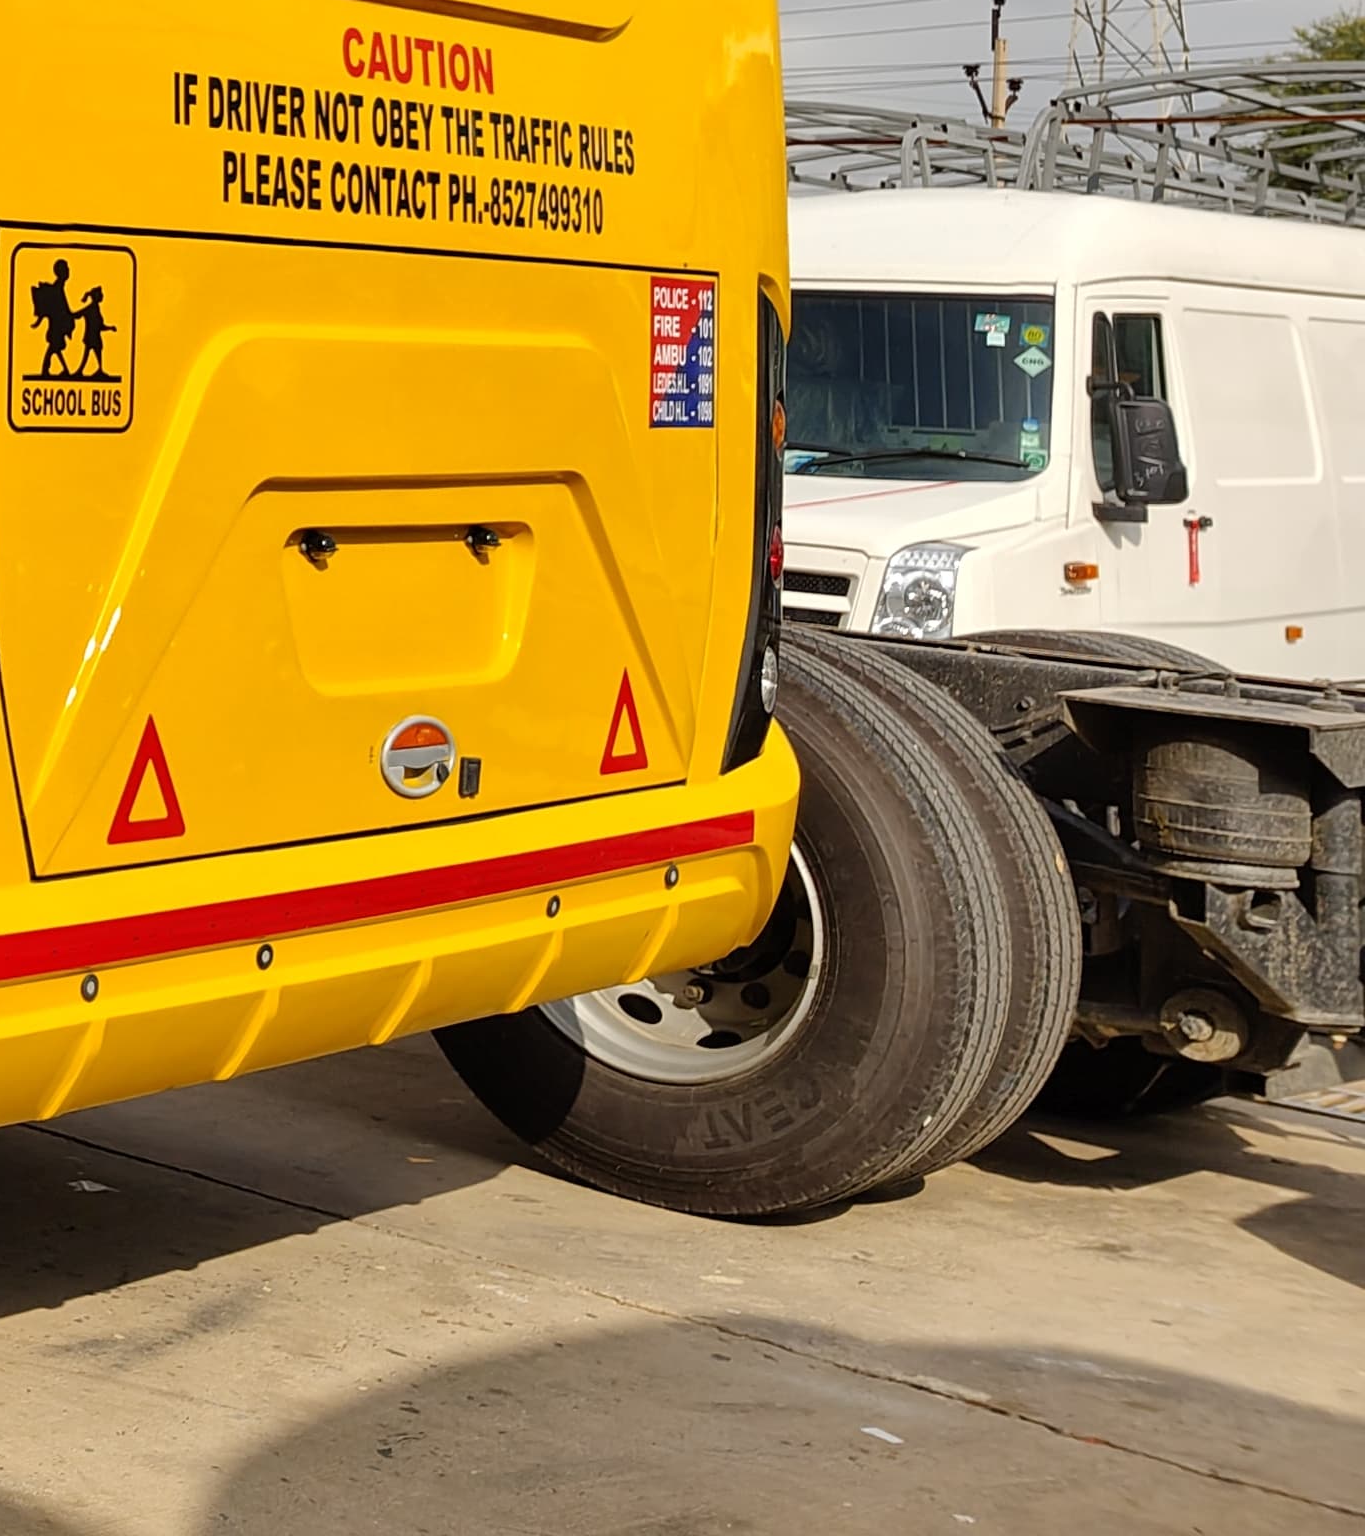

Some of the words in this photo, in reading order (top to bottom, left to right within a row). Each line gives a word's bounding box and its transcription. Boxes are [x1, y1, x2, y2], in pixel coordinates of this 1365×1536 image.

[341, 27, 495, 95] CAUTION
[173, 71, 198, 125] IF
[208, 76, 306, 139] DRIVER
[314, 89, 364, 146] NOT
[372, 98, 433, 151] OBEY
[441, 105, 484, 158] THE
[489, 112, 573, 169] TRAFFIC
[580, 124, 636, 176] RULES
[222, 151, 323, 211] PLEASE
[330, 163, 441, 222] CONTACT
[653, 286, 689, 310] POLICE
[698, 289, 713, 312] 112
[653, 315, 681, 338] FIRE
[698, 317, 713, 339] 101
[653, 344, 687, 366] AMBU
[698, 345, 713, 367] 102
[22, 388, 86, 416] SCHOOL
[91, 389, 122, 417] BUS
